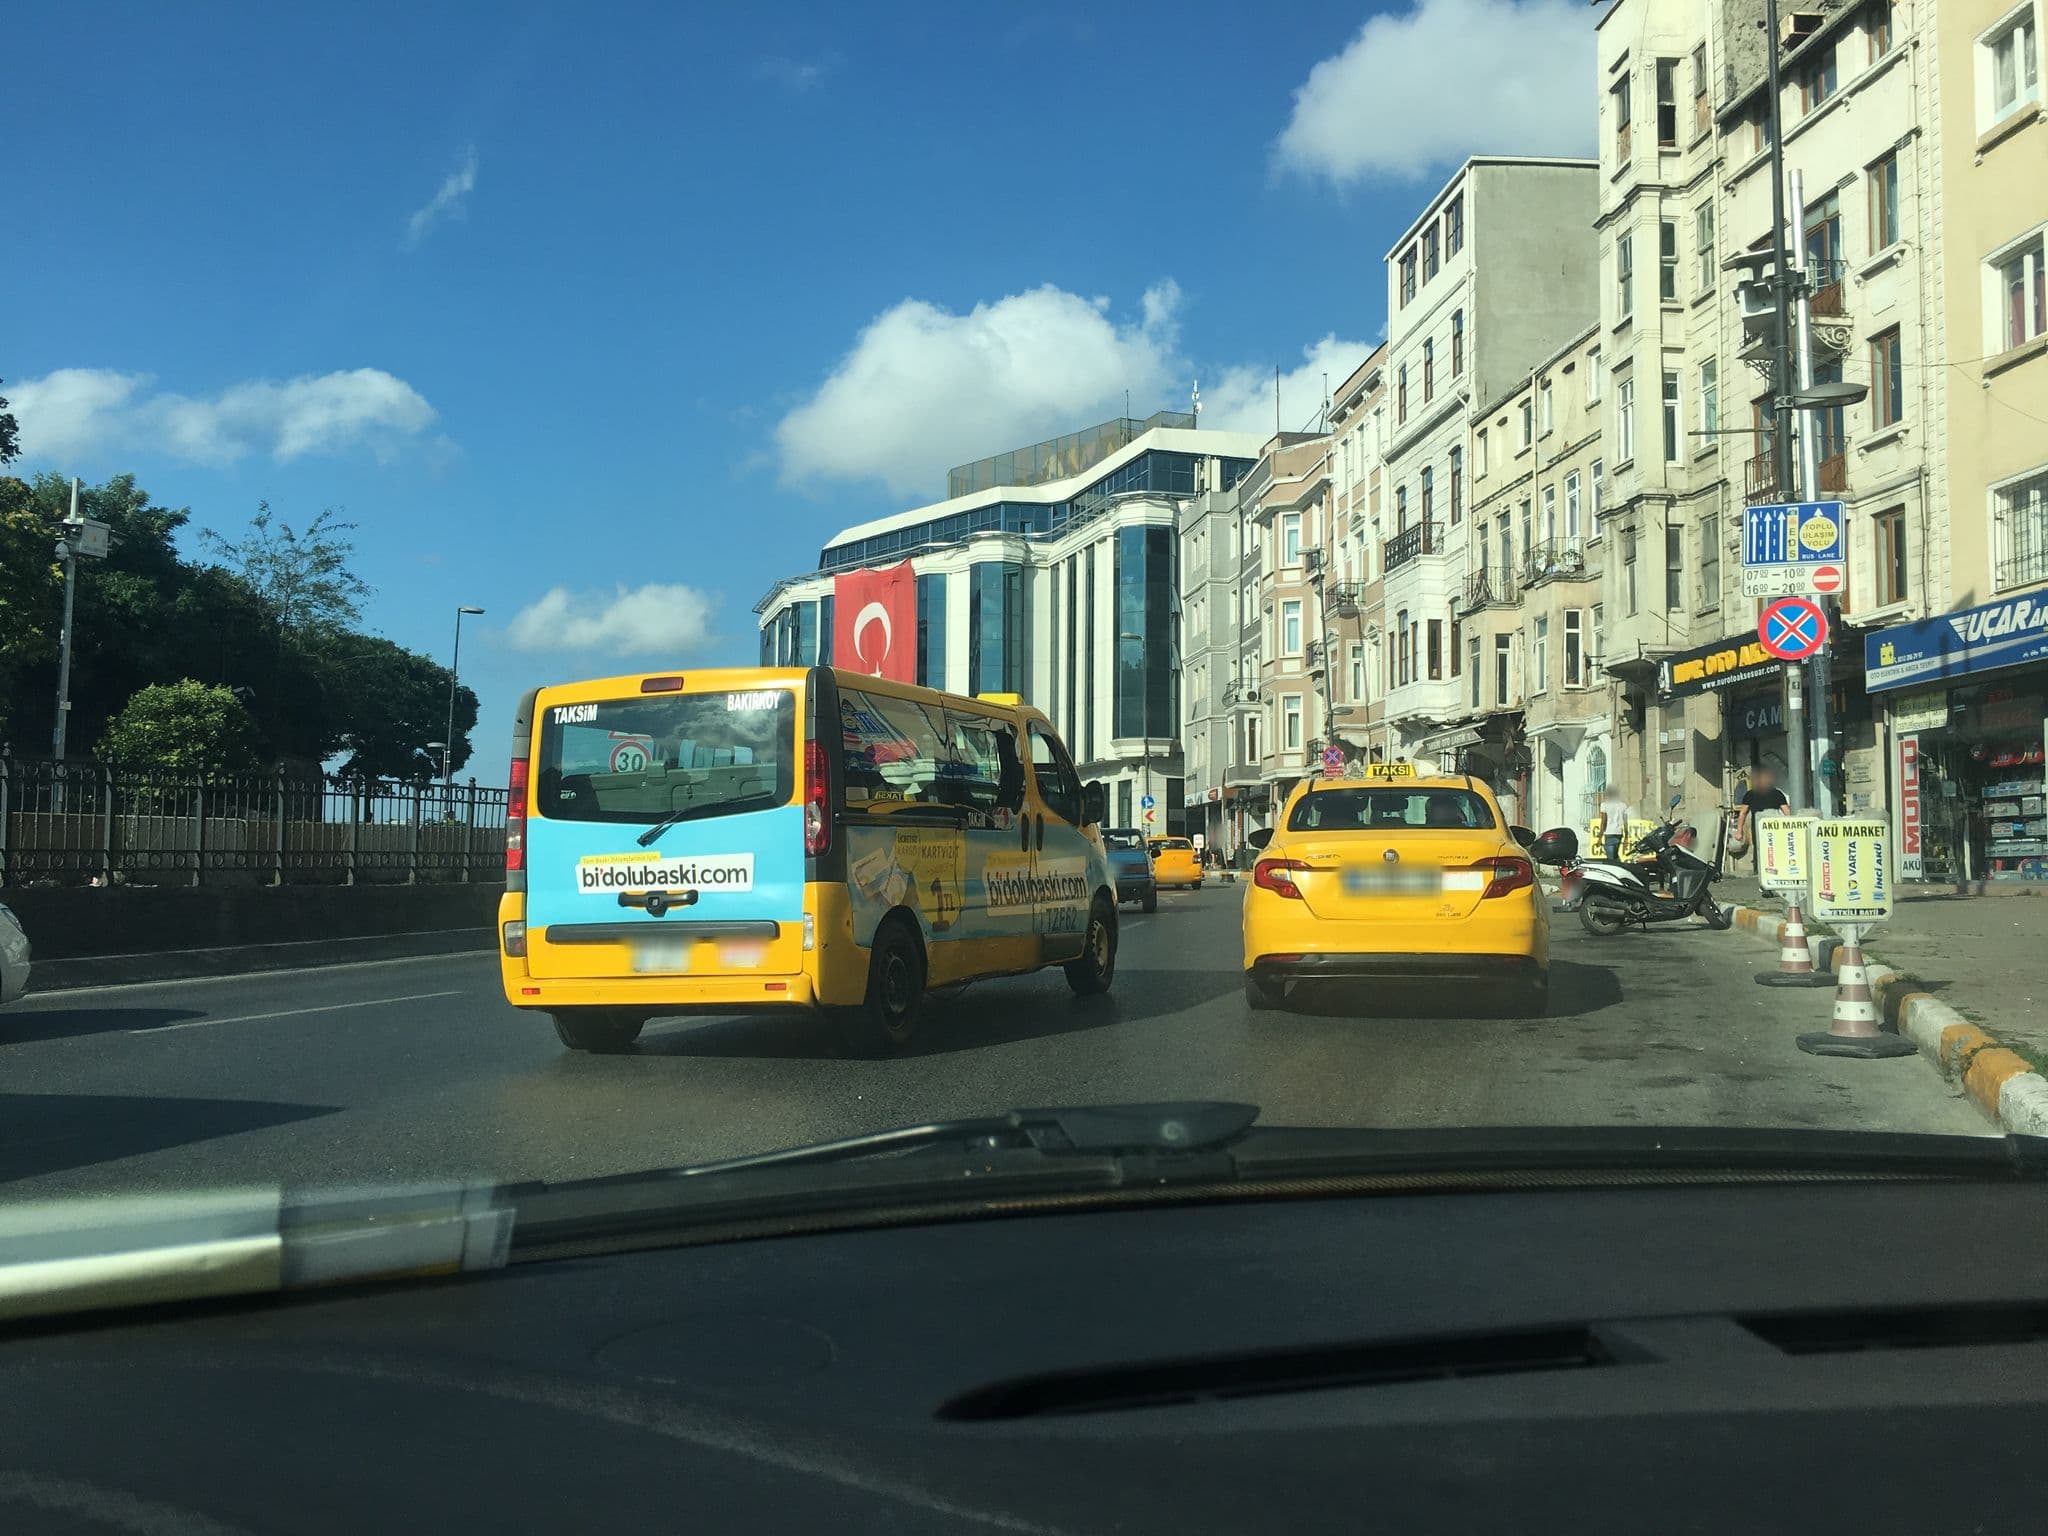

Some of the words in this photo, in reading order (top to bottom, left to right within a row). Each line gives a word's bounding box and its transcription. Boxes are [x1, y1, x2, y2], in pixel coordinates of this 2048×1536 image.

[1802, 531, 1834, 539] ULAŞIM
[1966, 600, 2031, 645] UÇAR
[617, 751, 643, 773] 30
[1816, 824, 1838, 838] AKÜ
[1842, 825, 1886, 838] MARKET
[1821, 841, 1829, 861] AKÜ
[1848, 841, 1857, 876] VARTA
[1873, 843, 1882, 866] AKÜ
[1902, 859, 1921, 872] AKÜ
